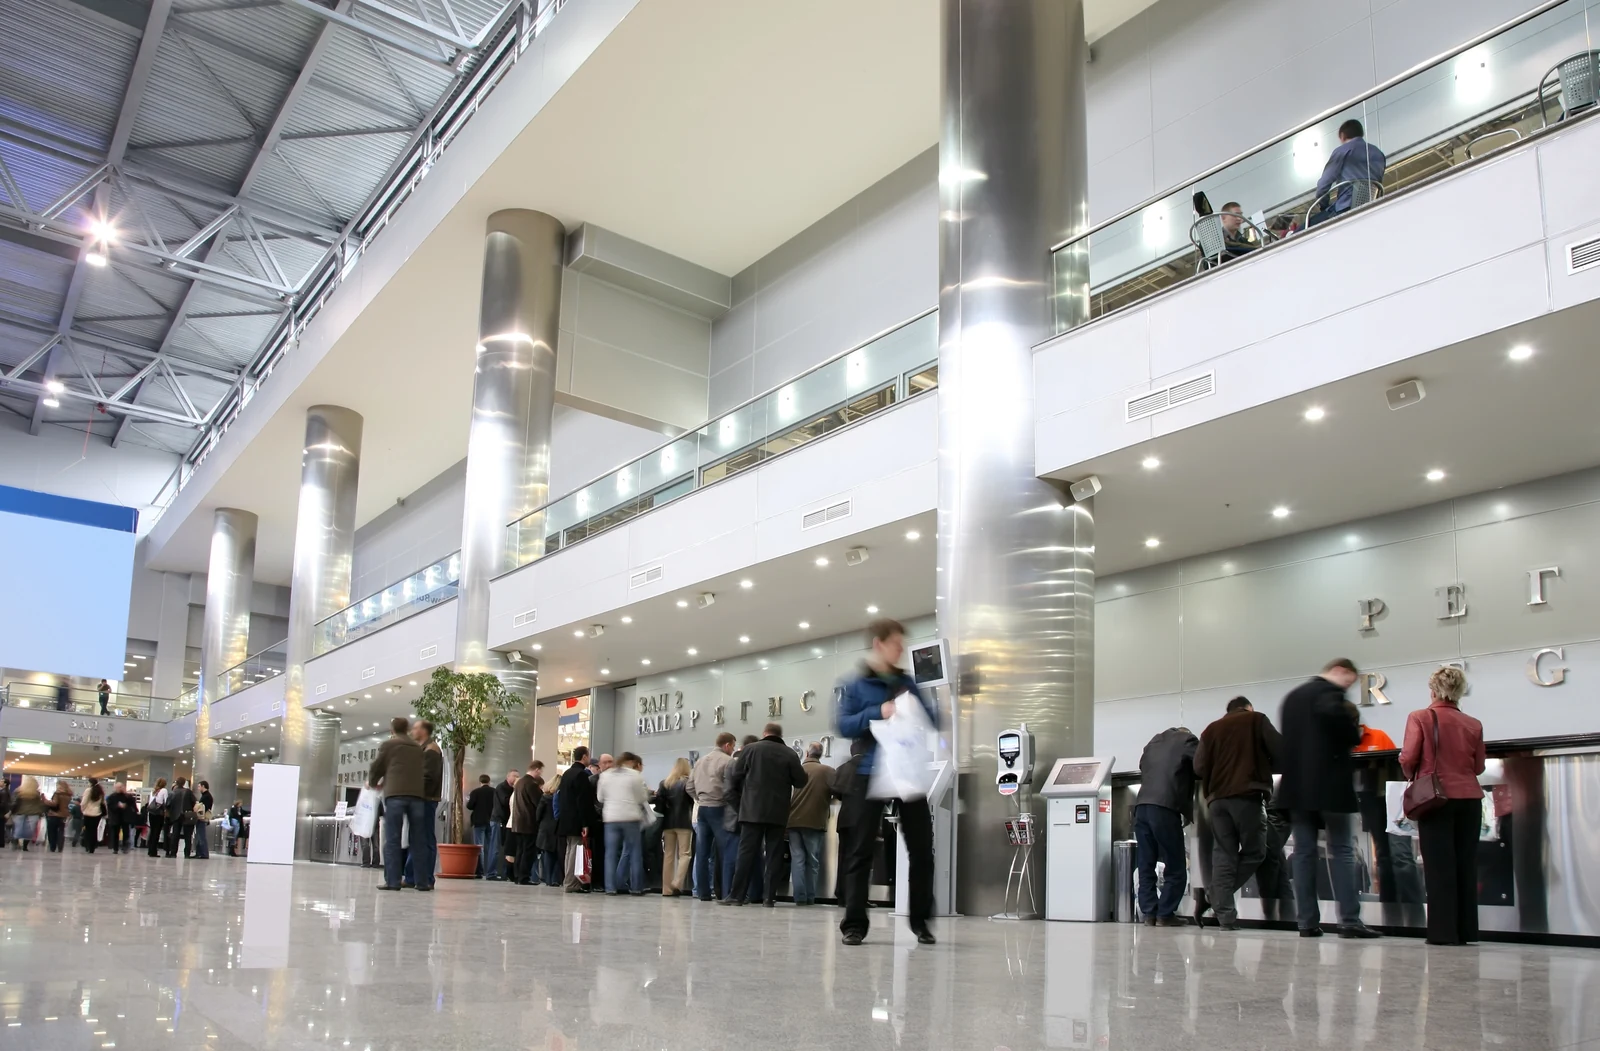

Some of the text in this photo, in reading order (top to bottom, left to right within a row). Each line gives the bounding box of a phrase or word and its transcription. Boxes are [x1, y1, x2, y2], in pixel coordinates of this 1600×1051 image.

[639, 690, 684, 714] ЗАЛ 2
[636, 711, 682, 736] HALL 2
[67, 733, 103, 745] HALL
